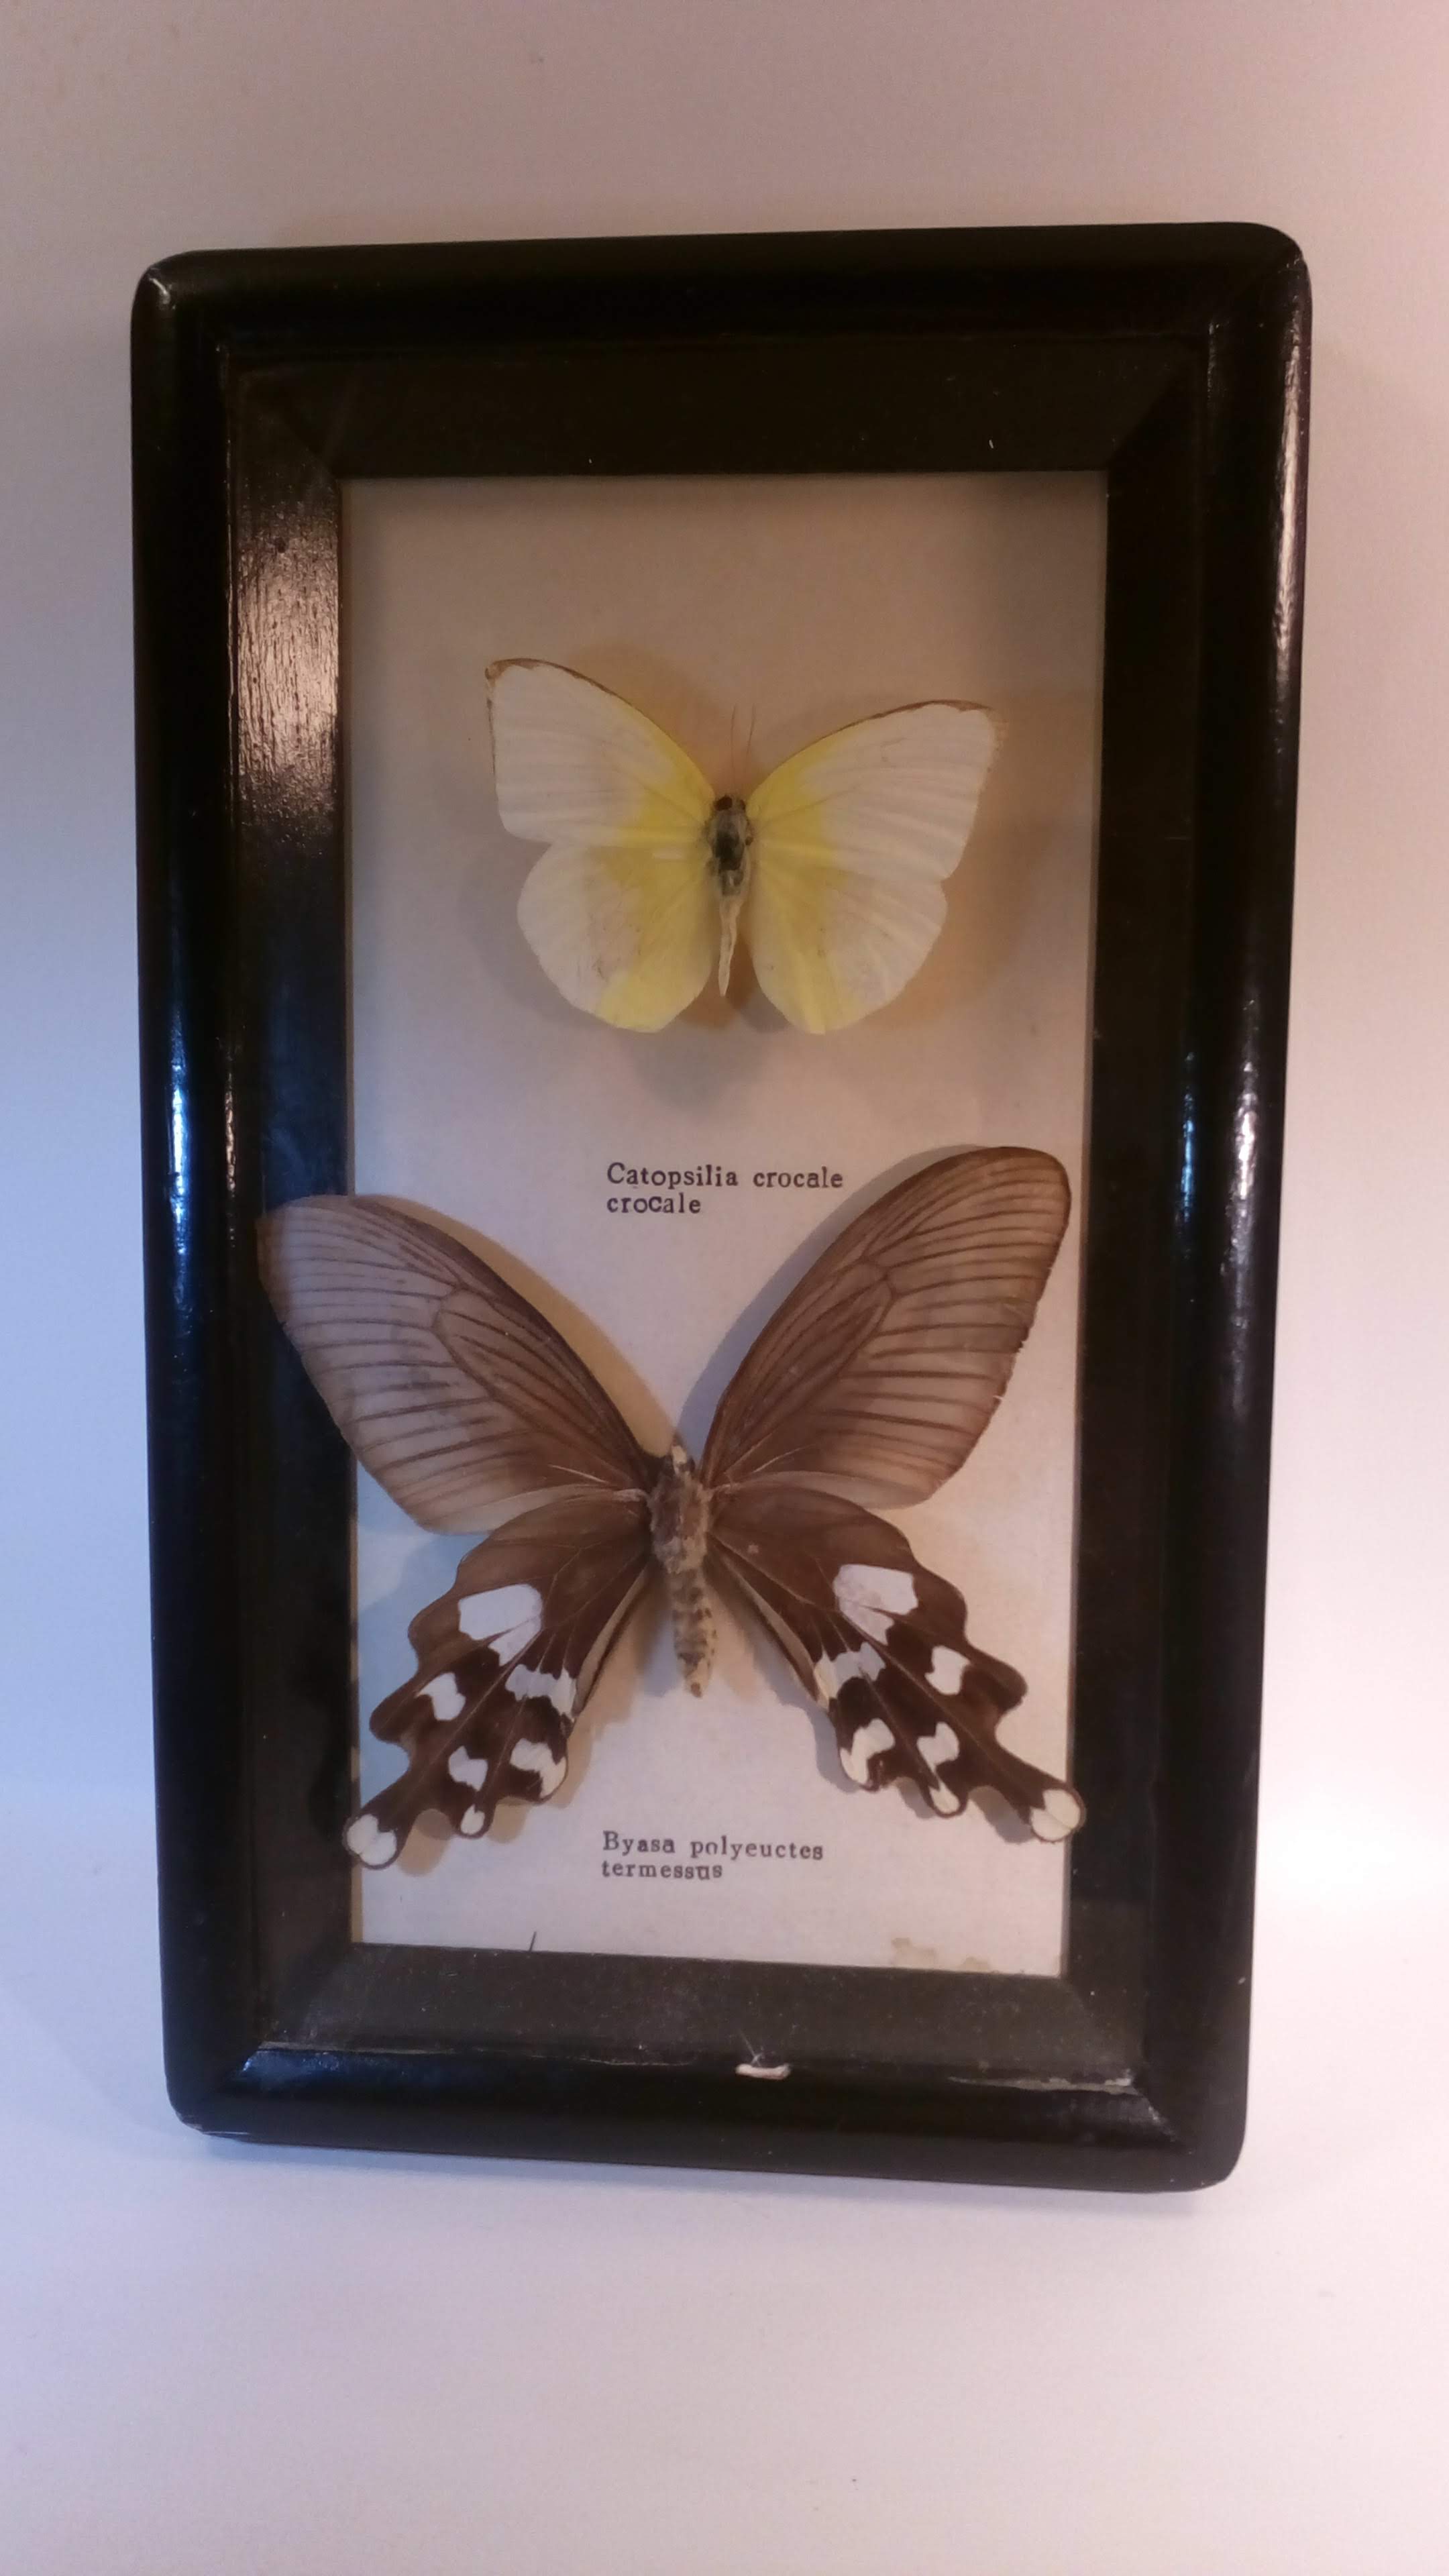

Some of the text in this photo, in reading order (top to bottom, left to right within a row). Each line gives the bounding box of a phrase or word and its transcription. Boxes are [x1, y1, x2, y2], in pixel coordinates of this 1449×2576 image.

[606, 1162, 843, 1189] Catopsilia crocale
[606, 1192, 701, 1214] crocale
[602, 1830, 823, 1861] Byasa polyeuctes
[602, 1860, 722, 1880] termessus
